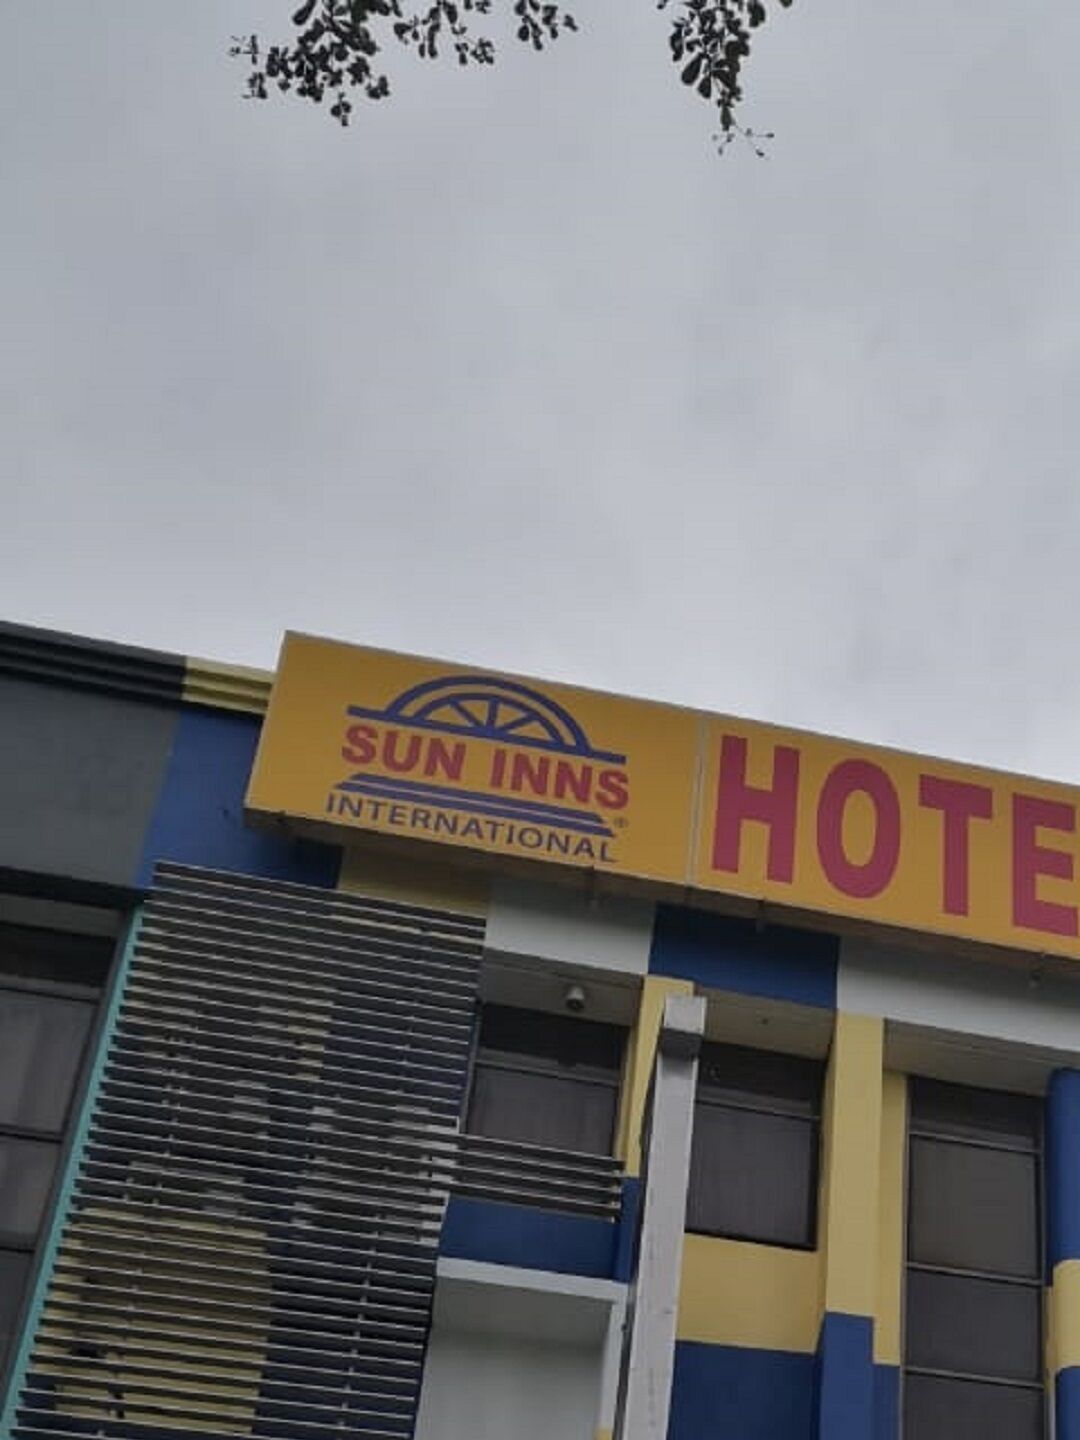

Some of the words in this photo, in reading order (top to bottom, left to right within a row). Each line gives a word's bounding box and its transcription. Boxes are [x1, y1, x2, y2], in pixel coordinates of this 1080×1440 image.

[341, 725, 467, 782] SUN
[490, 751, 630, 811] INNS
[326, 792, 618, 863] INTERNATIONAL
